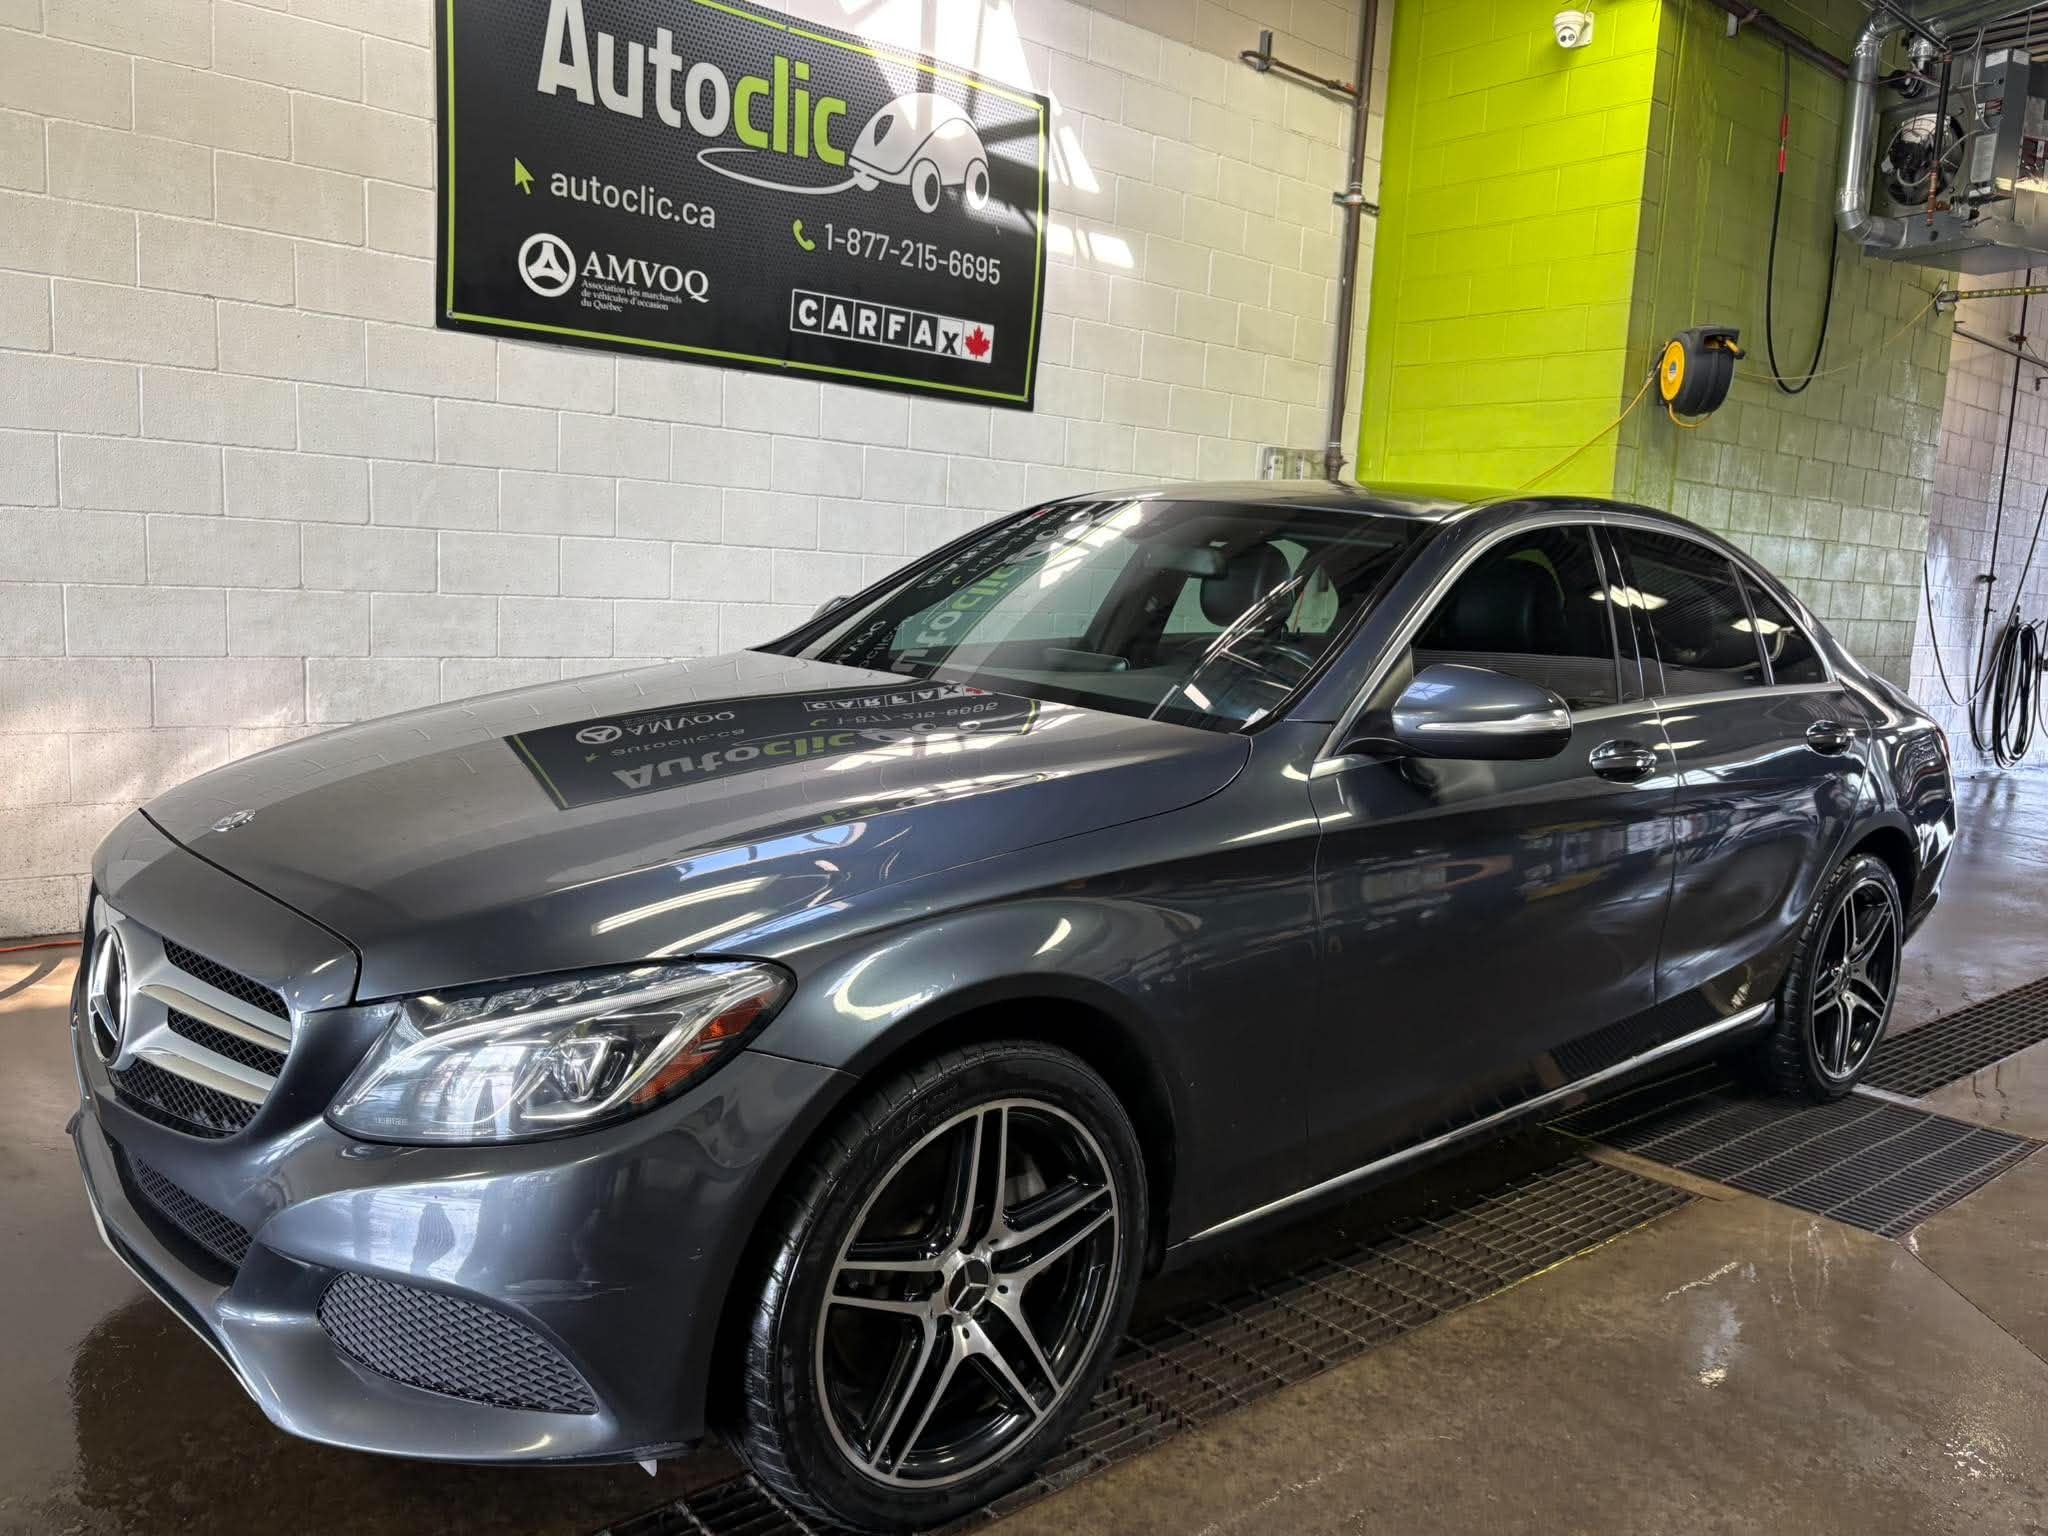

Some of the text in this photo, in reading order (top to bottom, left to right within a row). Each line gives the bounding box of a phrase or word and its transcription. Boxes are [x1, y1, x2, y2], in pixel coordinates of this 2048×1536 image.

[537, 0, 848, 167] Autoclic
[550, 170, 717, 229] autoclic.ca
[580, 250, 710, 303] AMVOQ
[825, 223, 1001, 286] 1-877-215-6695
[581, 279, 682, 304] Association des marchands
[581, 288, 592, 298] de
[593, 290, 629, 305] véhicules
[581, 297, 623, 313] du Québec
[797, 298, 961, 356] CARFAX
